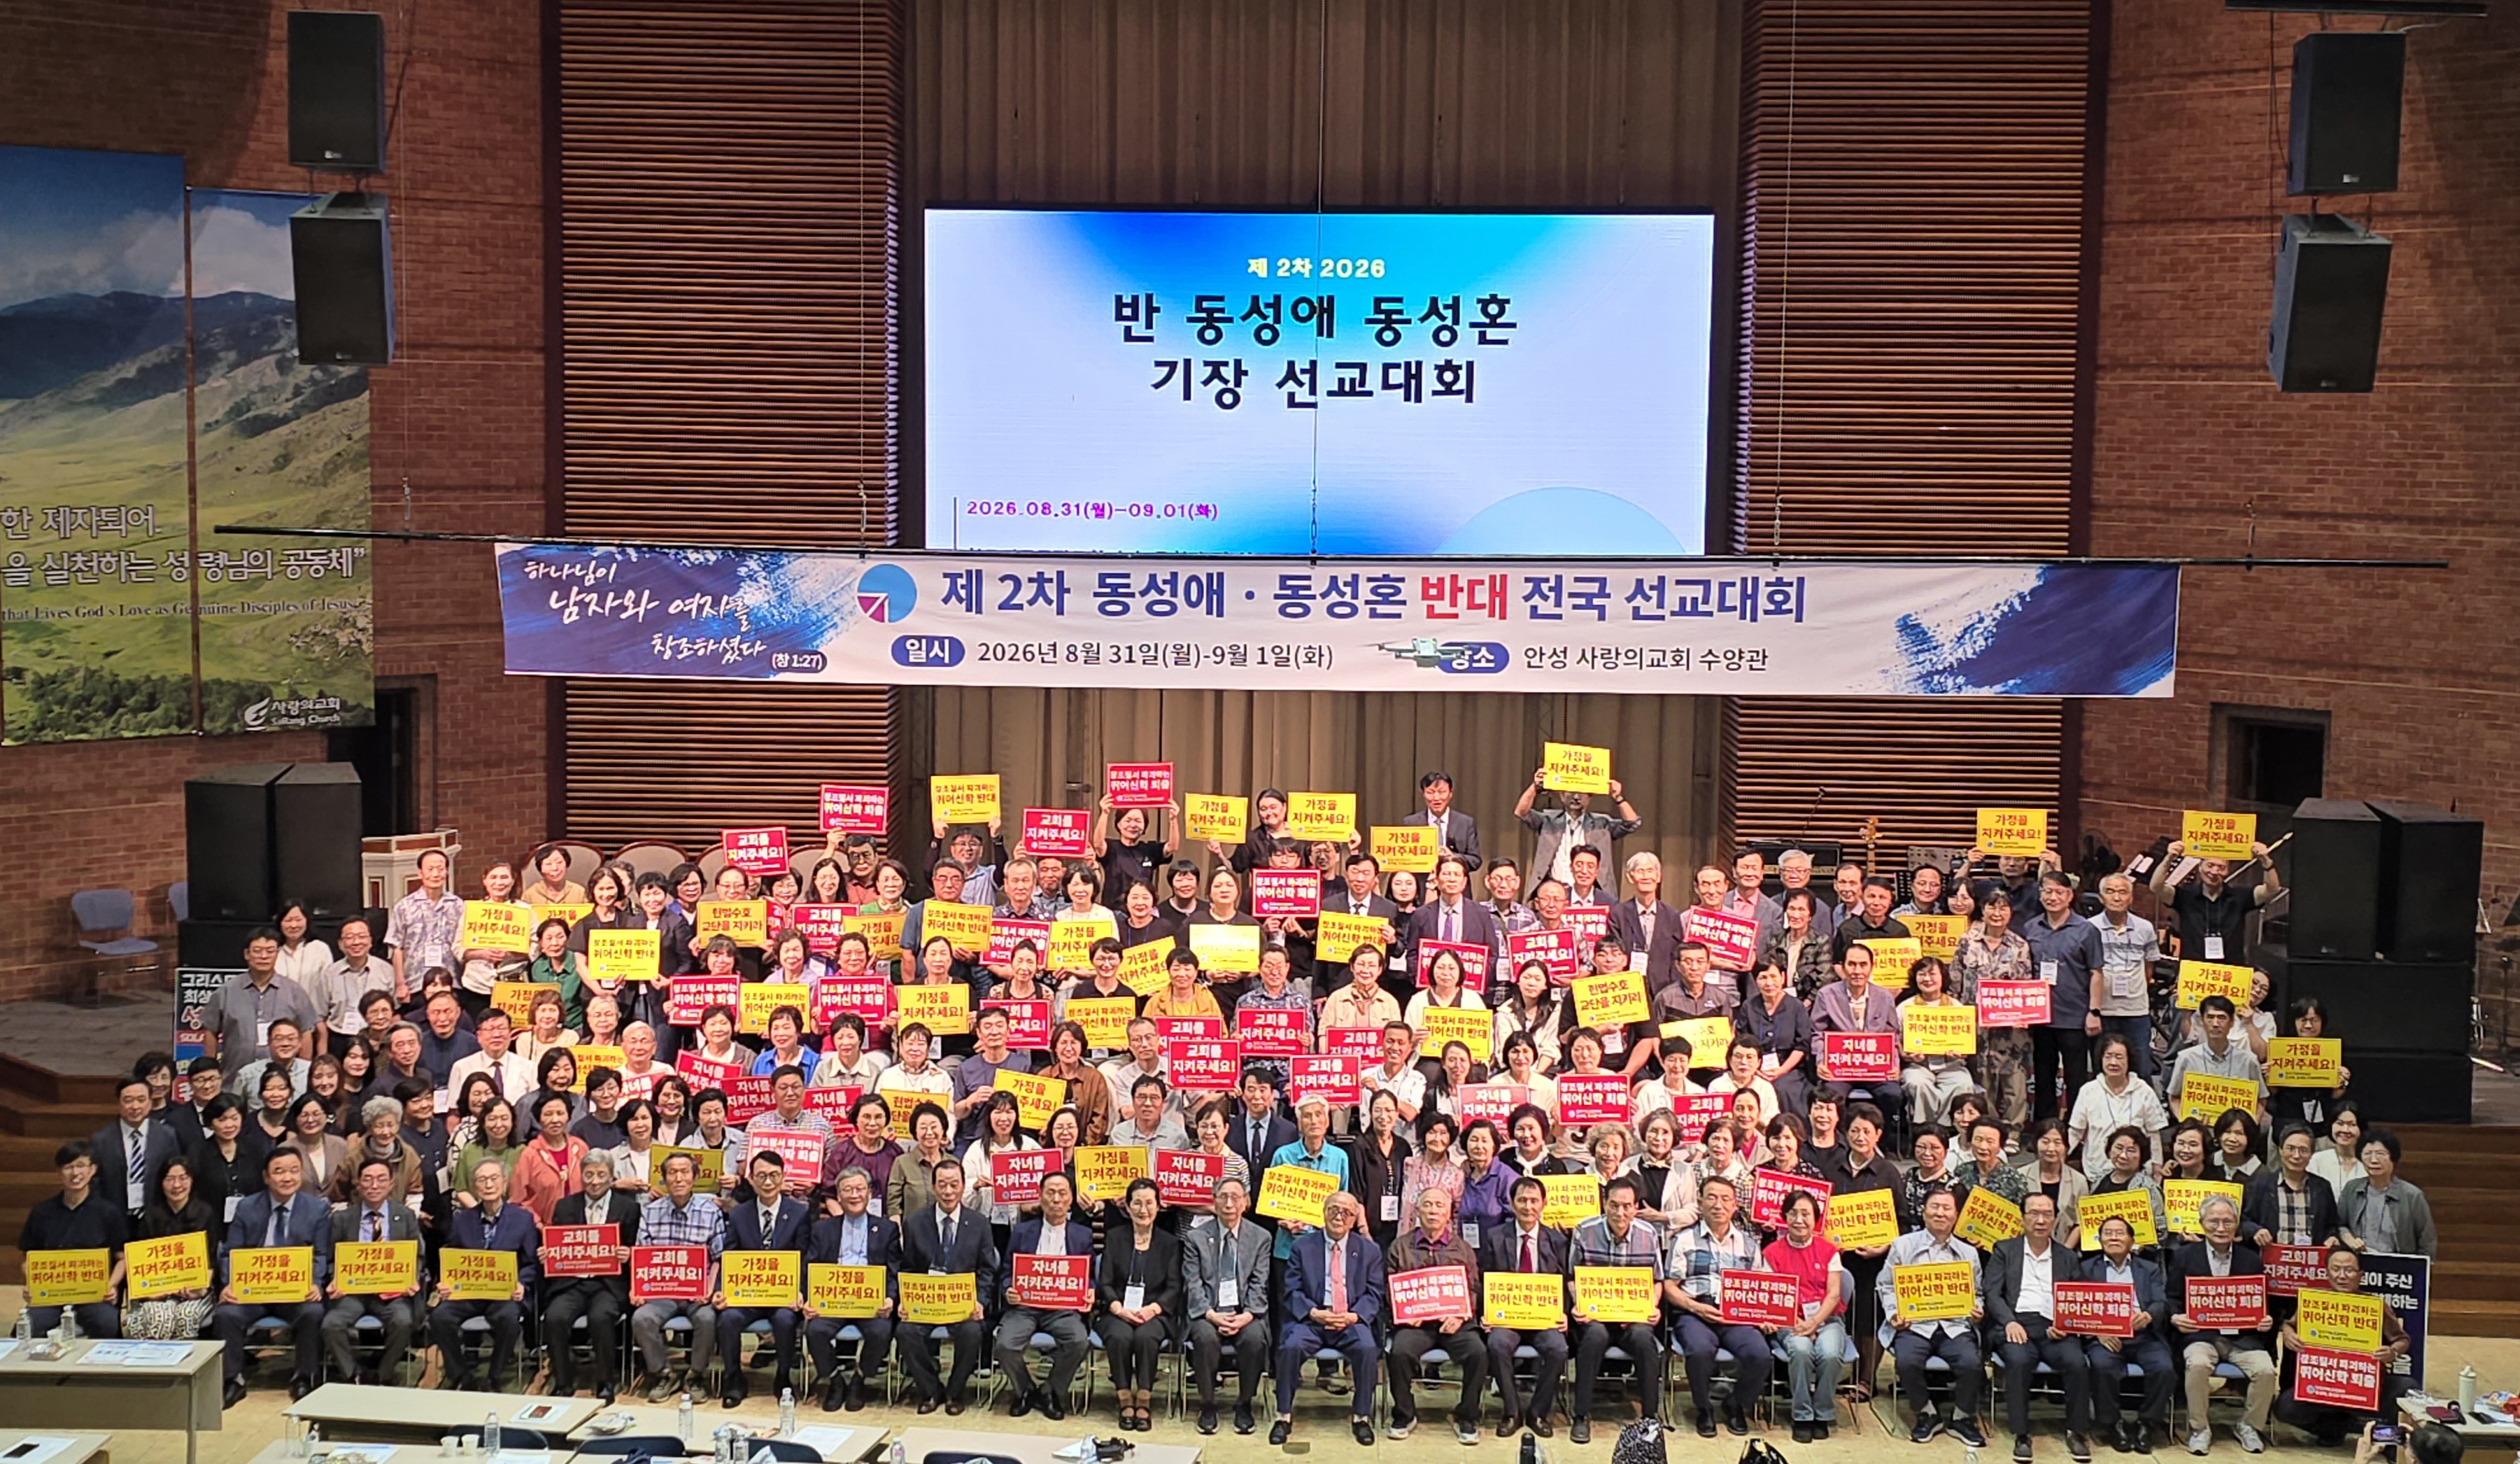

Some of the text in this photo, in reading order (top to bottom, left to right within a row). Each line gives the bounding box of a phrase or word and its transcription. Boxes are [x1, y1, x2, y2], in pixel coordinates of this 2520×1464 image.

[1248, 257, 1385, 278] 제 2차 2026
[1114, 294, 1518, 347] 반 동성애 동성혼
[1151, 358, 1478, 409] 기장 선교대회
[42, 504, 162, 539] 제자되어.
[1, 551, 33, 586] 을
[41, 551, 157, 584] 실천하는
[162, 549, 272, 582] 성령님의
[525, 561, 617, 584] 하나님이
[119, 604, 151, 617] Love
[155, 606, 169, 615] as
[241, 600, 298, 616] Disciples
[302, 599, 317, 611] of
[941, 569, 1806, 623] 제 2차 동성애 동성혼 반대 전국 선교대회
[549, 589, 751, 632] 남자와 여자를
[651, 633, 768, 664] 창조하셨다
[791, 652, 823, 670] 1:27)
[905, 638, 1333, 670] 일시 2026년 8월 31일(월)-9월 1일(화)
[1524, 647, 1568, 670] 안성
[1576, 645, 1691, 671] 사랑의교회
[1699, 648, 1768, 672] 수양관
[271, 698, 340, 715] 사랑의교회
[181, 974, 236, 987] 그리스
[1158, 1171, 1215, 1188] 지켜주세요
[2264, 1265, 2326, 1280] 지켜주세요
[2385, 1274, 2412, 1289] 주신
